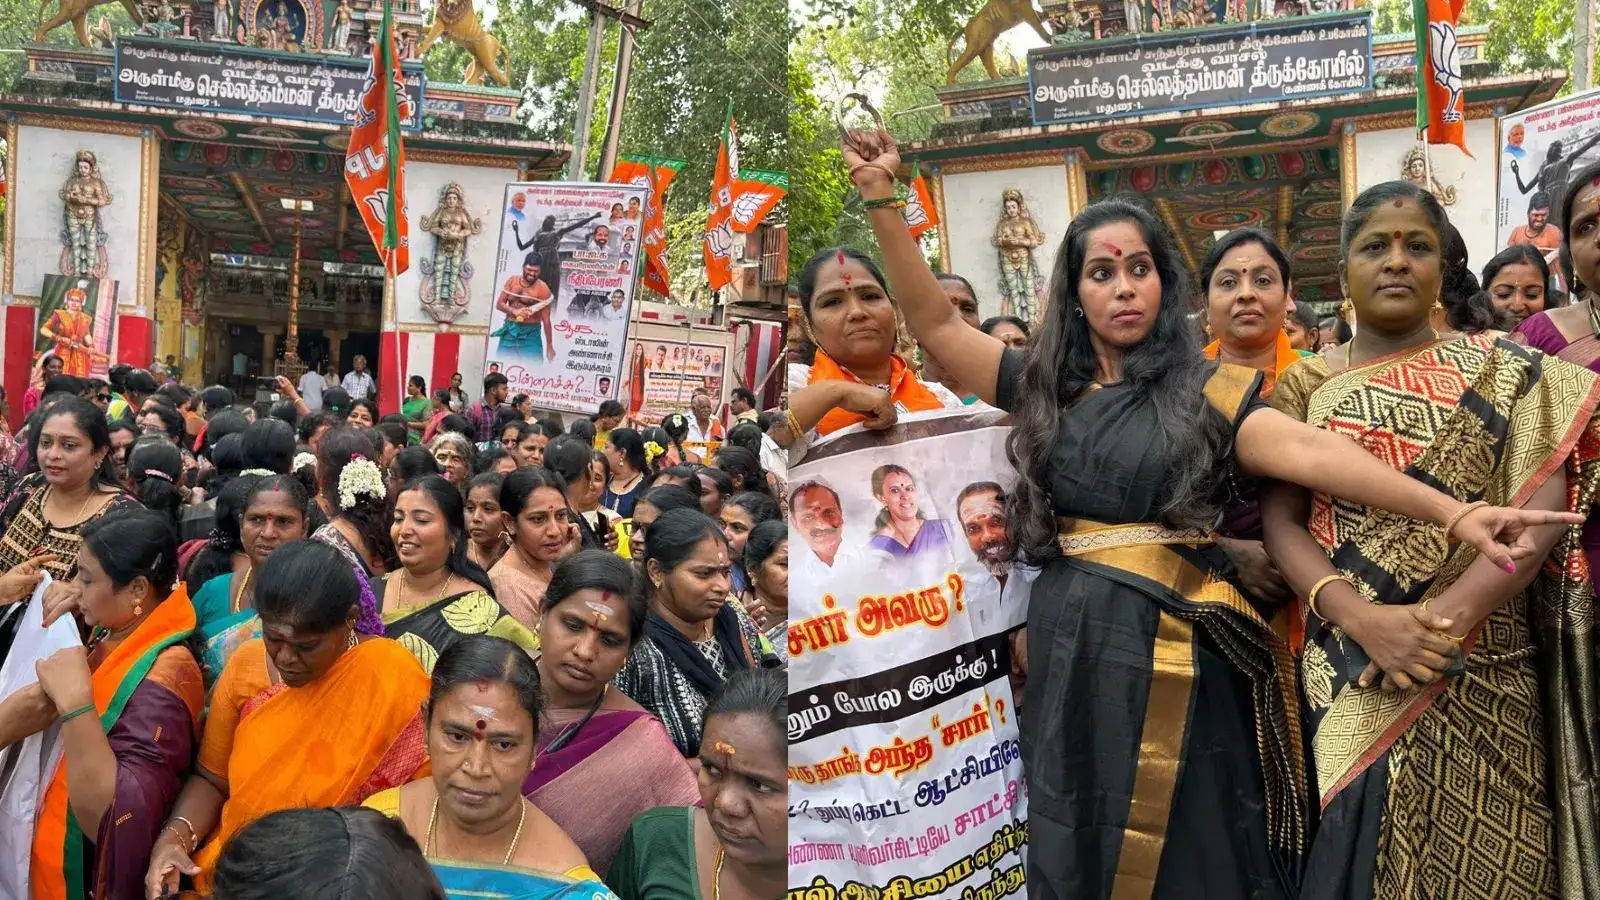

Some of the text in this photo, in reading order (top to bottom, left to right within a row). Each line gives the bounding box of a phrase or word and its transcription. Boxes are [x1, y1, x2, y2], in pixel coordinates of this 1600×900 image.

[122, 45, 178, 63] அருள்மிகு
[180, 52, 222, 67] மீனாட்சி
[1035, 56, 1093, 73] அருள்மிகு
[1095, 47, 1140, 65] மீனாட்சி
[1238, 29, 1316, 54] திருக்கோயில்
[1141, 46, 1268, 74] வடக்கு வாசல்
[118, 68, 195, 92] அருள்மிகு
[197, 74, 314, 109] செல்லத்தம்மன்
[221, 68, 336, 90] வடக்கு வாசல்
[1034, 48, 1366, 104] அருள்மிகு செல்லத்தம்மன் திருக்கோயில்
[834, 687, 902, 714] போல
[863, 735, 933, 778] அந்த
[852, 798, 910, 824] கெட்ட
[788, 837, 845, 867] ண்ணா
